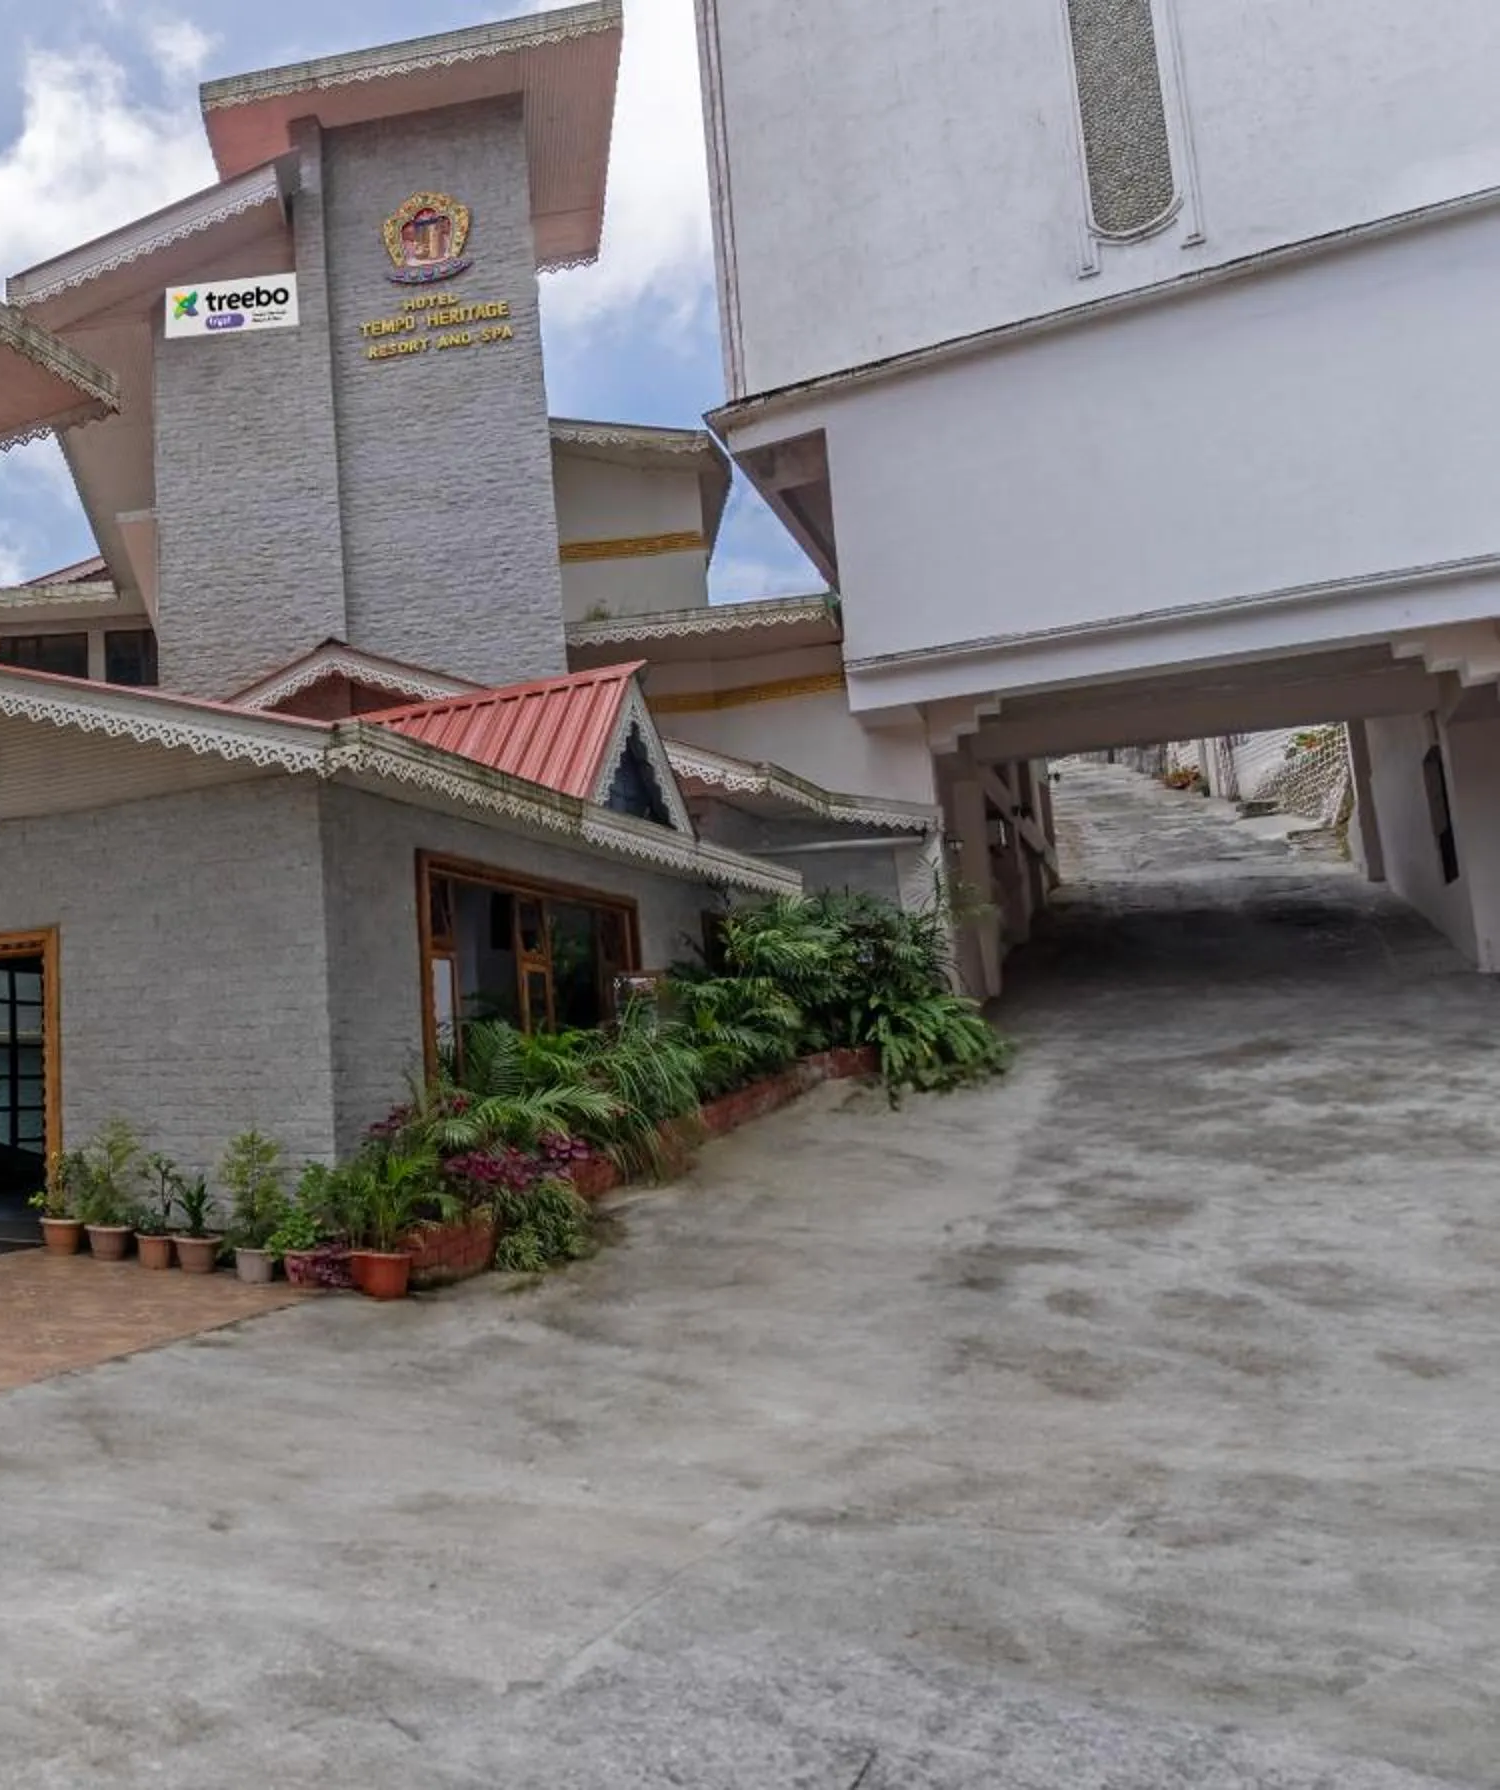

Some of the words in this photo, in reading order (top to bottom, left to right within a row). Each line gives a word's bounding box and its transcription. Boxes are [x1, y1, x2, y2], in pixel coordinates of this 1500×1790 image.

[206, 286, 289, 311] treebo
[404, 294, 459, 312] HOTEL
[361, 315, 416, 337] TEMPO
[427, 302, 509, 326] HERITAGE
[368, 337, 428, 360] RESORT
[436, 331, 471, 349] AND
[480, 325, 513, 343] SPA
